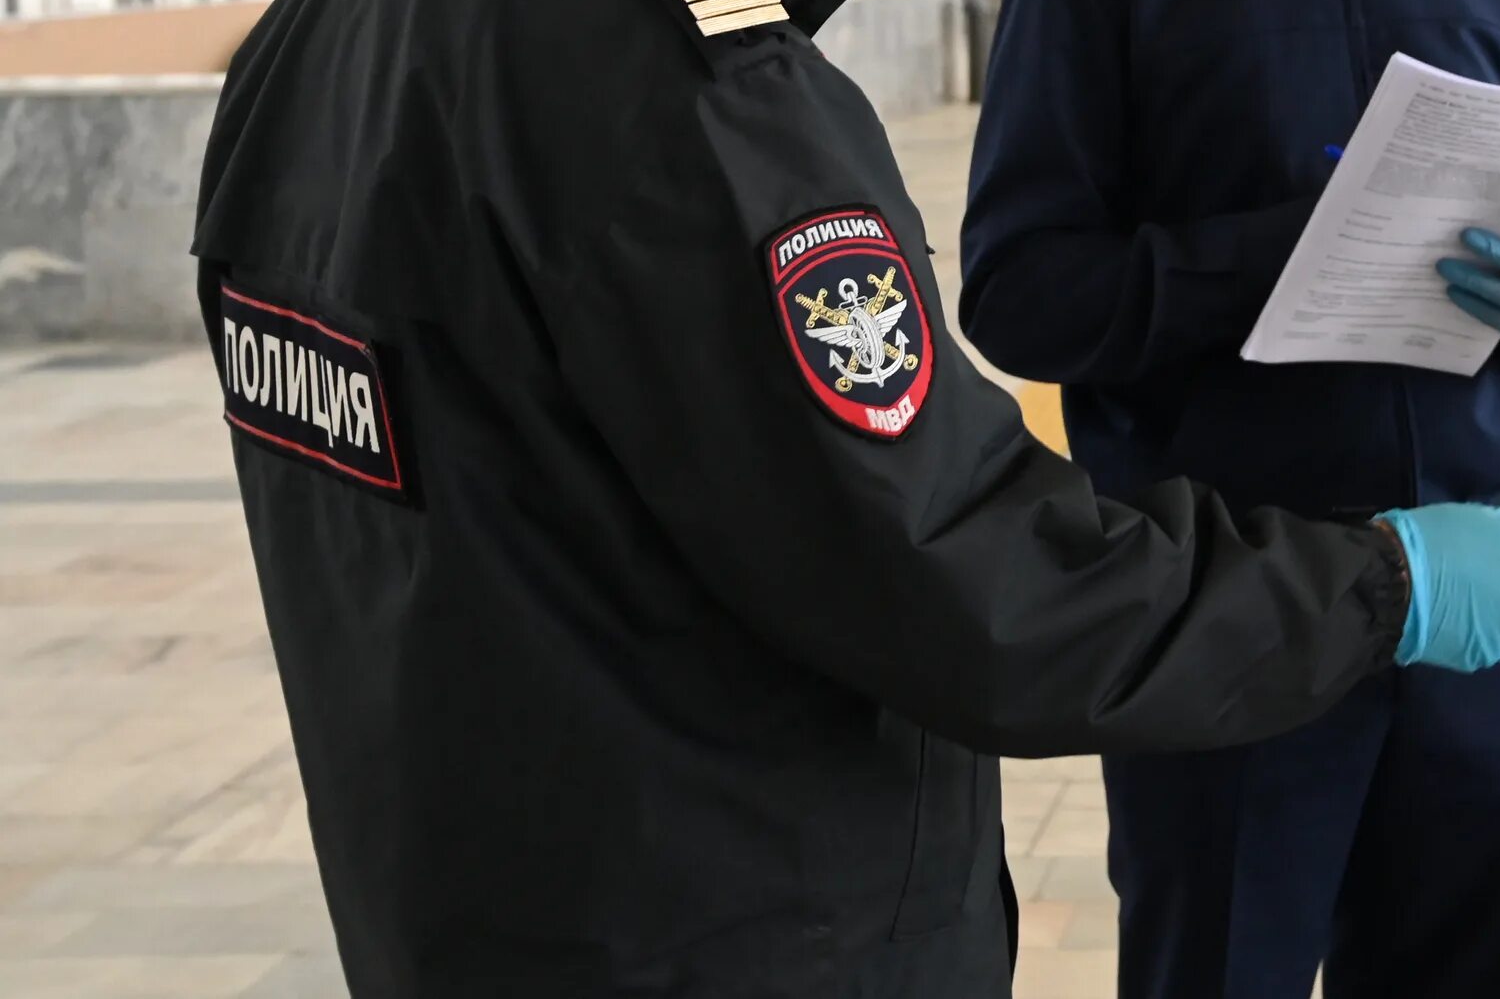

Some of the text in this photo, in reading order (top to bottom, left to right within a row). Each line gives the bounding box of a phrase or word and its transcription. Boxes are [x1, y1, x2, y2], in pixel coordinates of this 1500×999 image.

[779, 218, 884, 268] ПОЛИЦИЯ
[224, 316, 381, 454] ПОЛИЦИЯ
[864, 394, 916, 432] МВД
